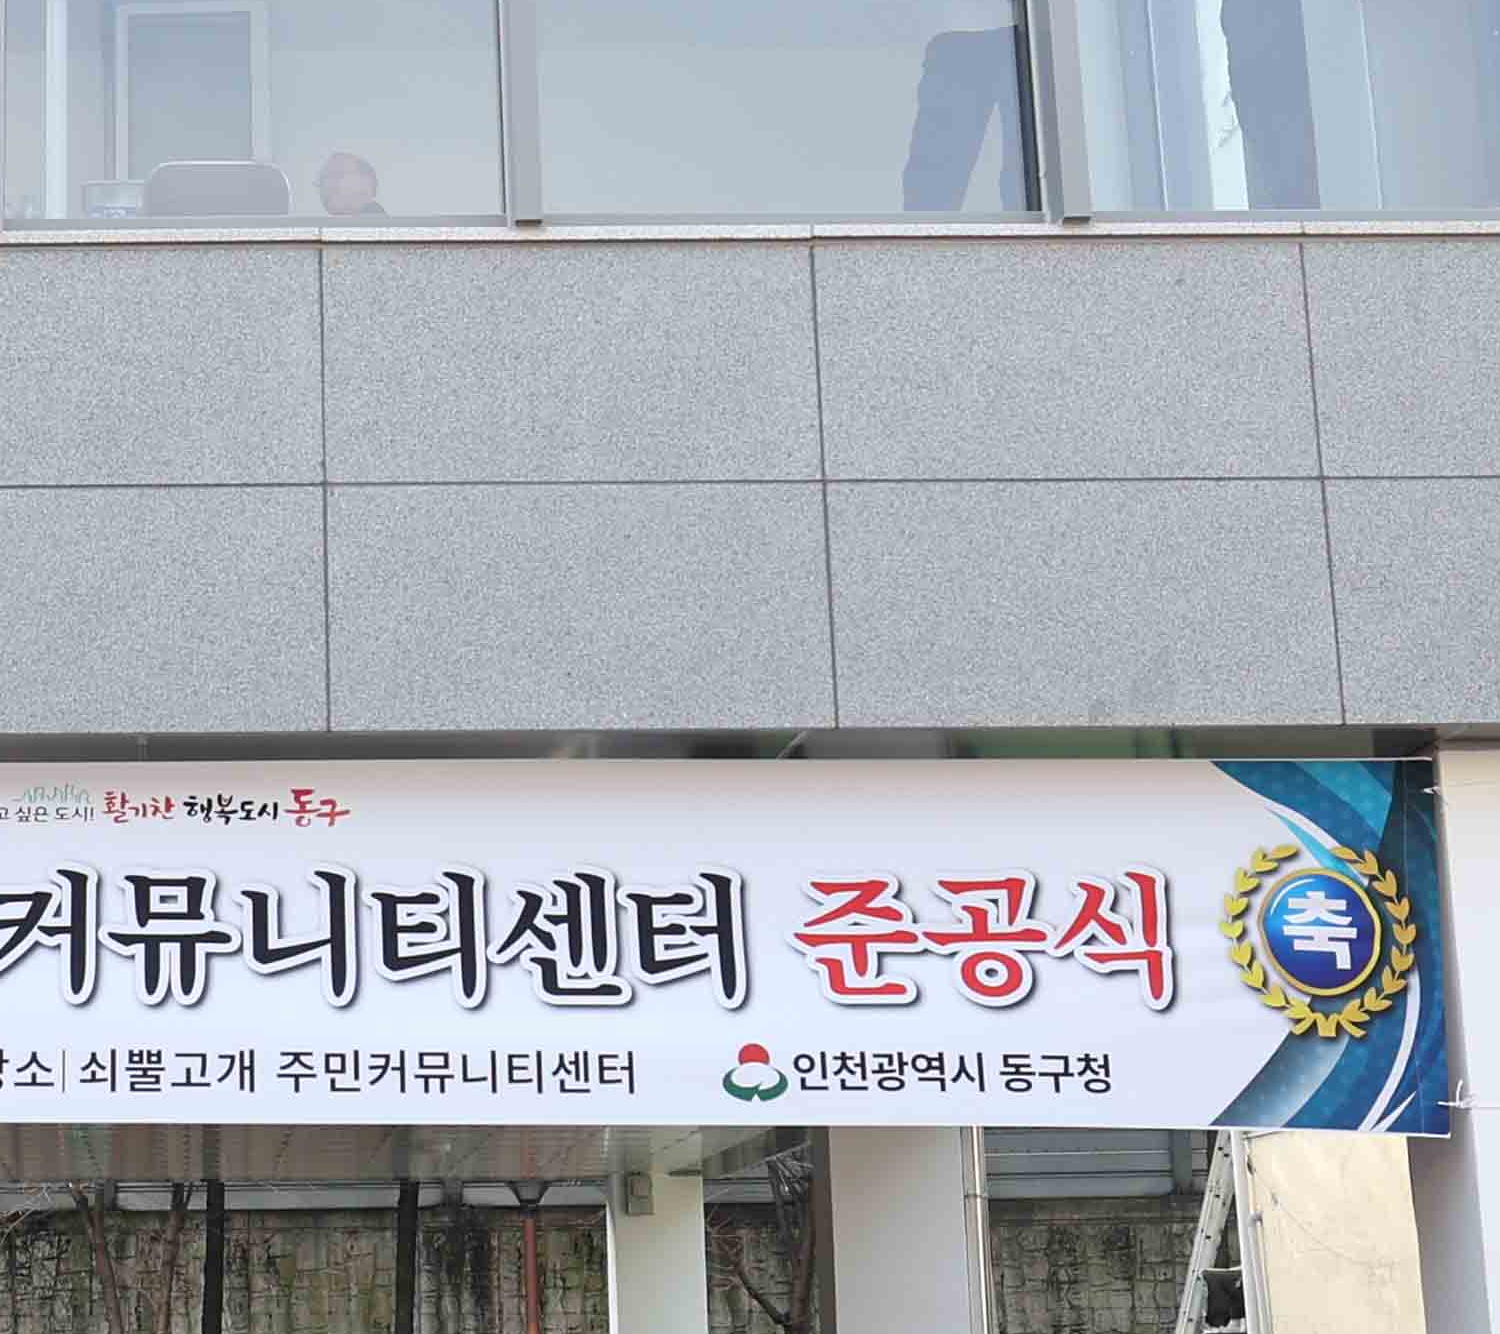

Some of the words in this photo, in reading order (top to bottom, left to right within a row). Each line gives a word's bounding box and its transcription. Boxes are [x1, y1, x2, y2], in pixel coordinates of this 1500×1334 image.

[15, 805, 49, 823] 싶은
[55, 806, 95, 822] 도시!
[102, 790, 176, 825] 활기찬
[182, 793, 280, 826] 행복도시
[285, 788, 351, 828] 동구
[793, 869, 1170, 1002] 준공식
[1282, 890, 1358, 970] 축
[78, 1048, 256, 1094] 쇠뿔고개
[275, 1048, 637, 1095] 주민커뮤니티센터
[791, 1050, 987, 1095] 인천광역시
[998, 1051, 1113, 1095] 동구청
